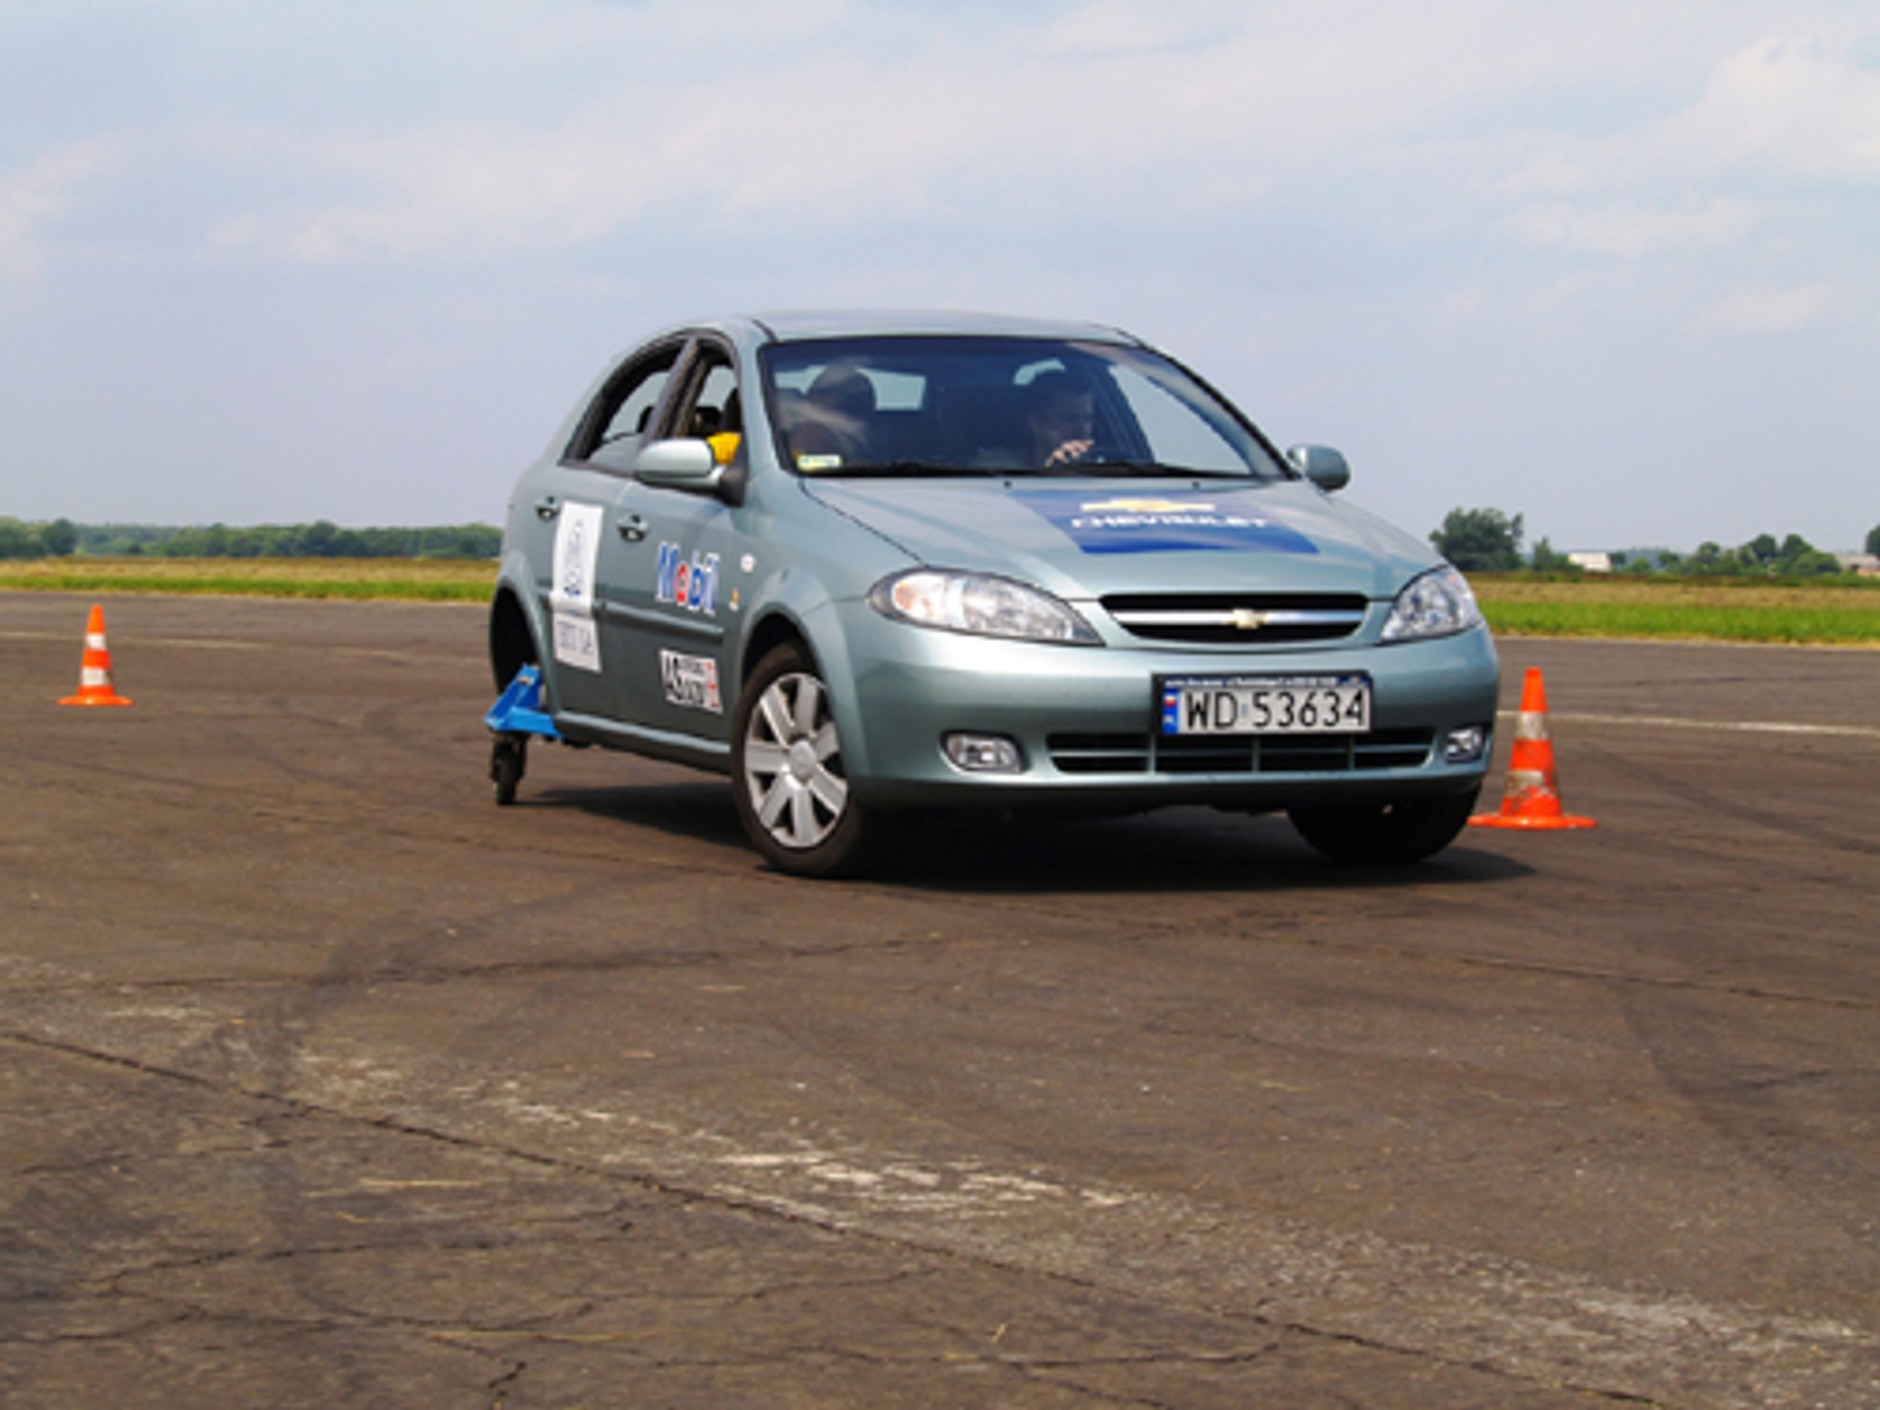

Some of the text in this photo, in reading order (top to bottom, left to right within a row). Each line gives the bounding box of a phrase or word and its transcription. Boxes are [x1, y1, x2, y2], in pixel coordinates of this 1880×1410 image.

[656, 541, 720, 616] Mobil
[1186, 689, 1364, 730] WD 53634
